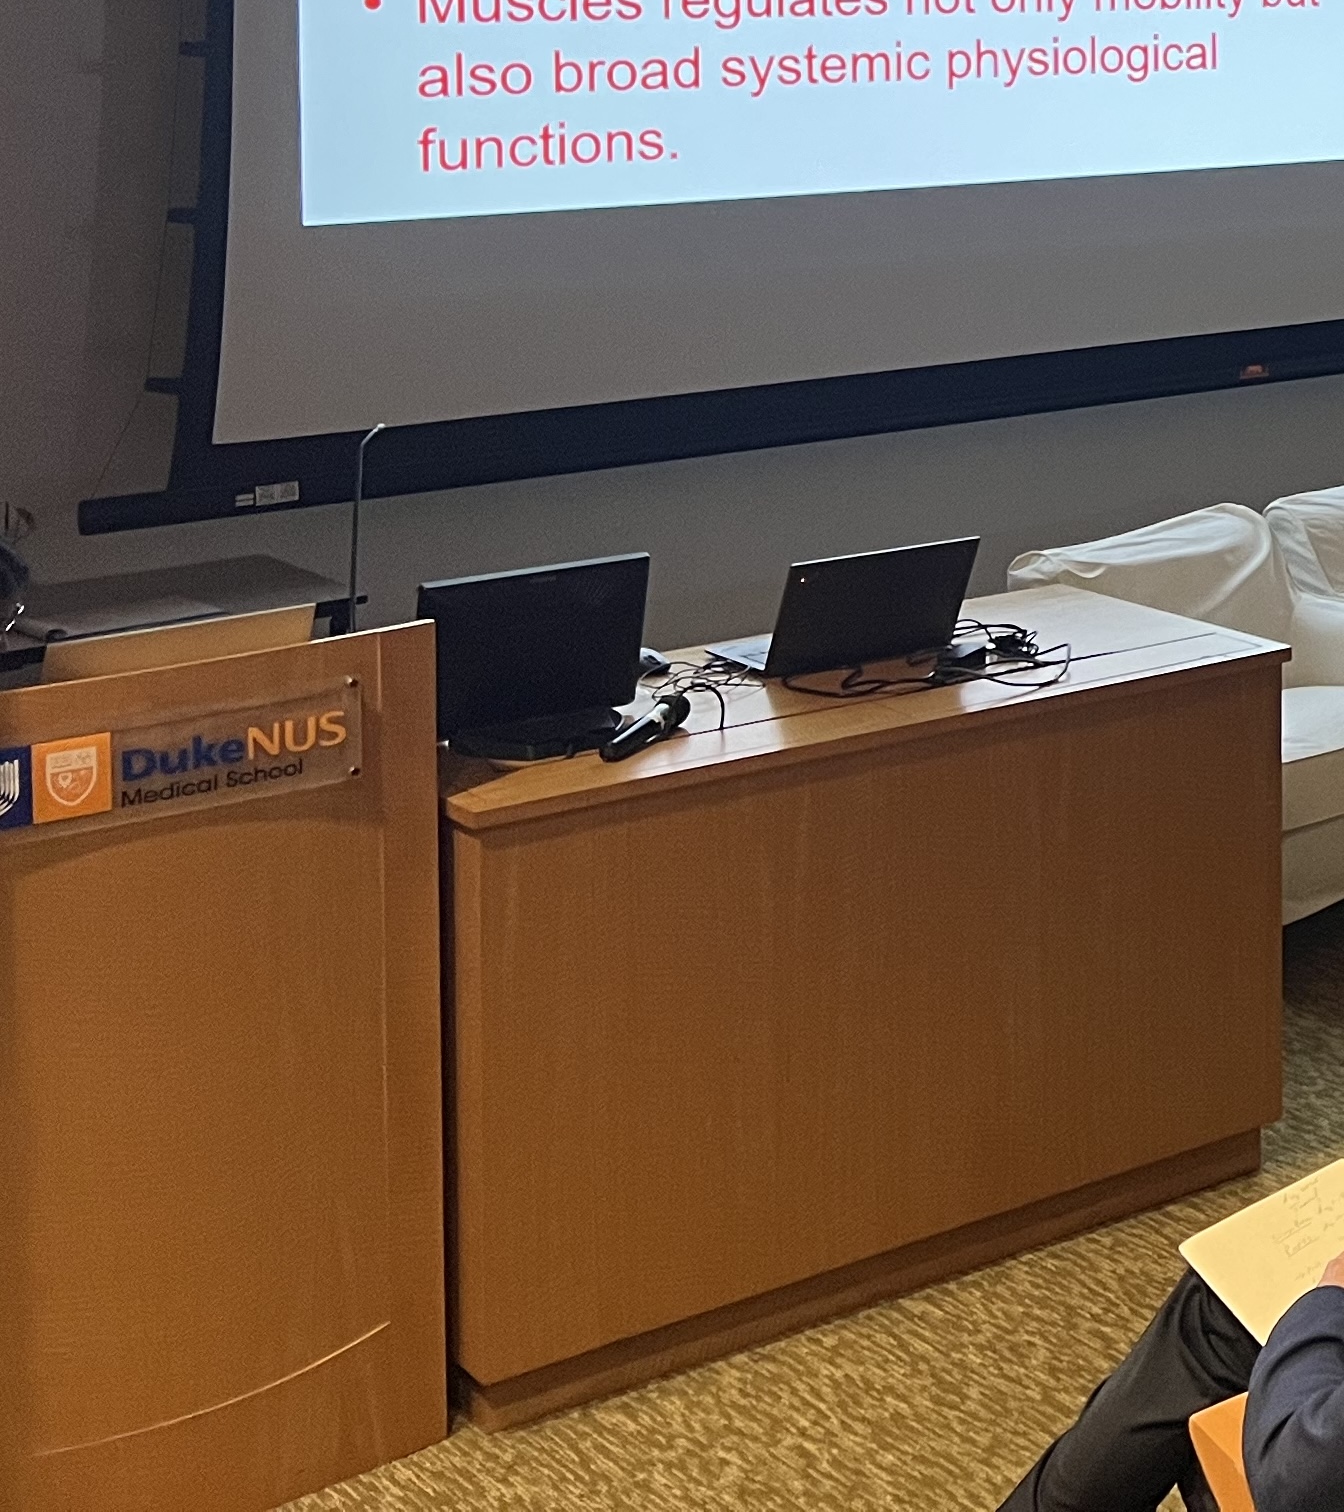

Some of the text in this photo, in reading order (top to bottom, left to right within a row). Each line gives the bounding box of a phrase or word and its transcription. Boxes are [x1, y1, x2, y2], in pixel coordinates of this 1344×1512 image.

[418, 32, 1217, 98] also broad systemic physiological
[417, 121, 678, 172] functions.
[121, 710, 347, 782] DukeNUS
[120, 758, 303, 808] Medical School
